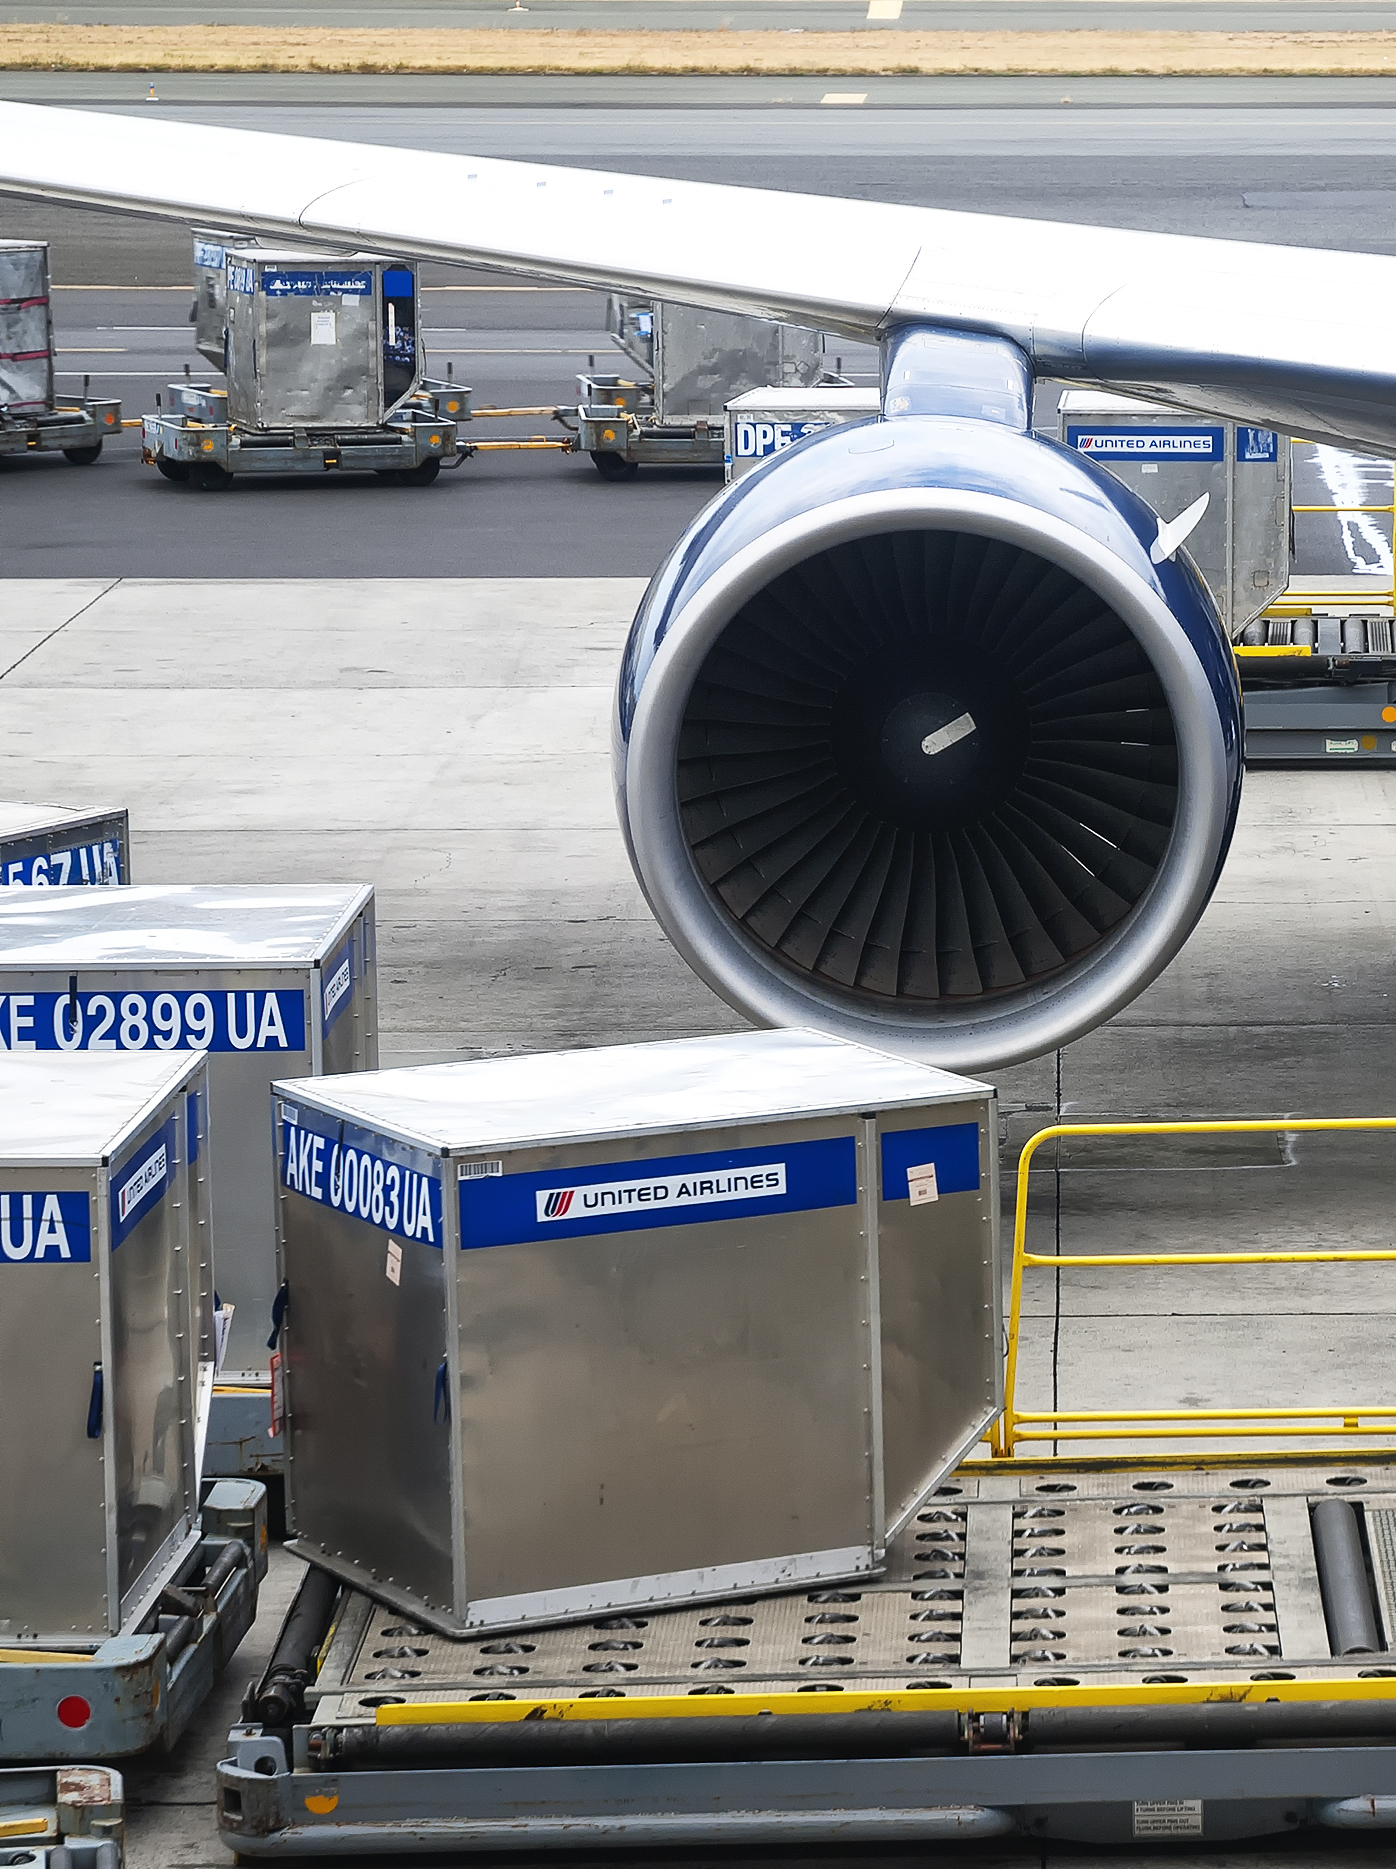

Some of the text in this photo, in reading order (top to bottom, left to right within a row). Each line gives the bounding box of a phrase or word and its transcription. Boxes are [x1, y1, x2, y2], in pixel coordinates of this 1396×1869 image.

[1094, 439, 1212, 449] UNITED AIRLINES
[0, 851, 72, 886] 567
[53, 993, 215, 1050] 02899
[227, 992, 289, 1049] UA
[286, 1126, 435, 1243] AKE 00083 UA
[583, 1171, 780, 1209] UNITED AIRLINES
[0, 1194, 72, 1260] UA
